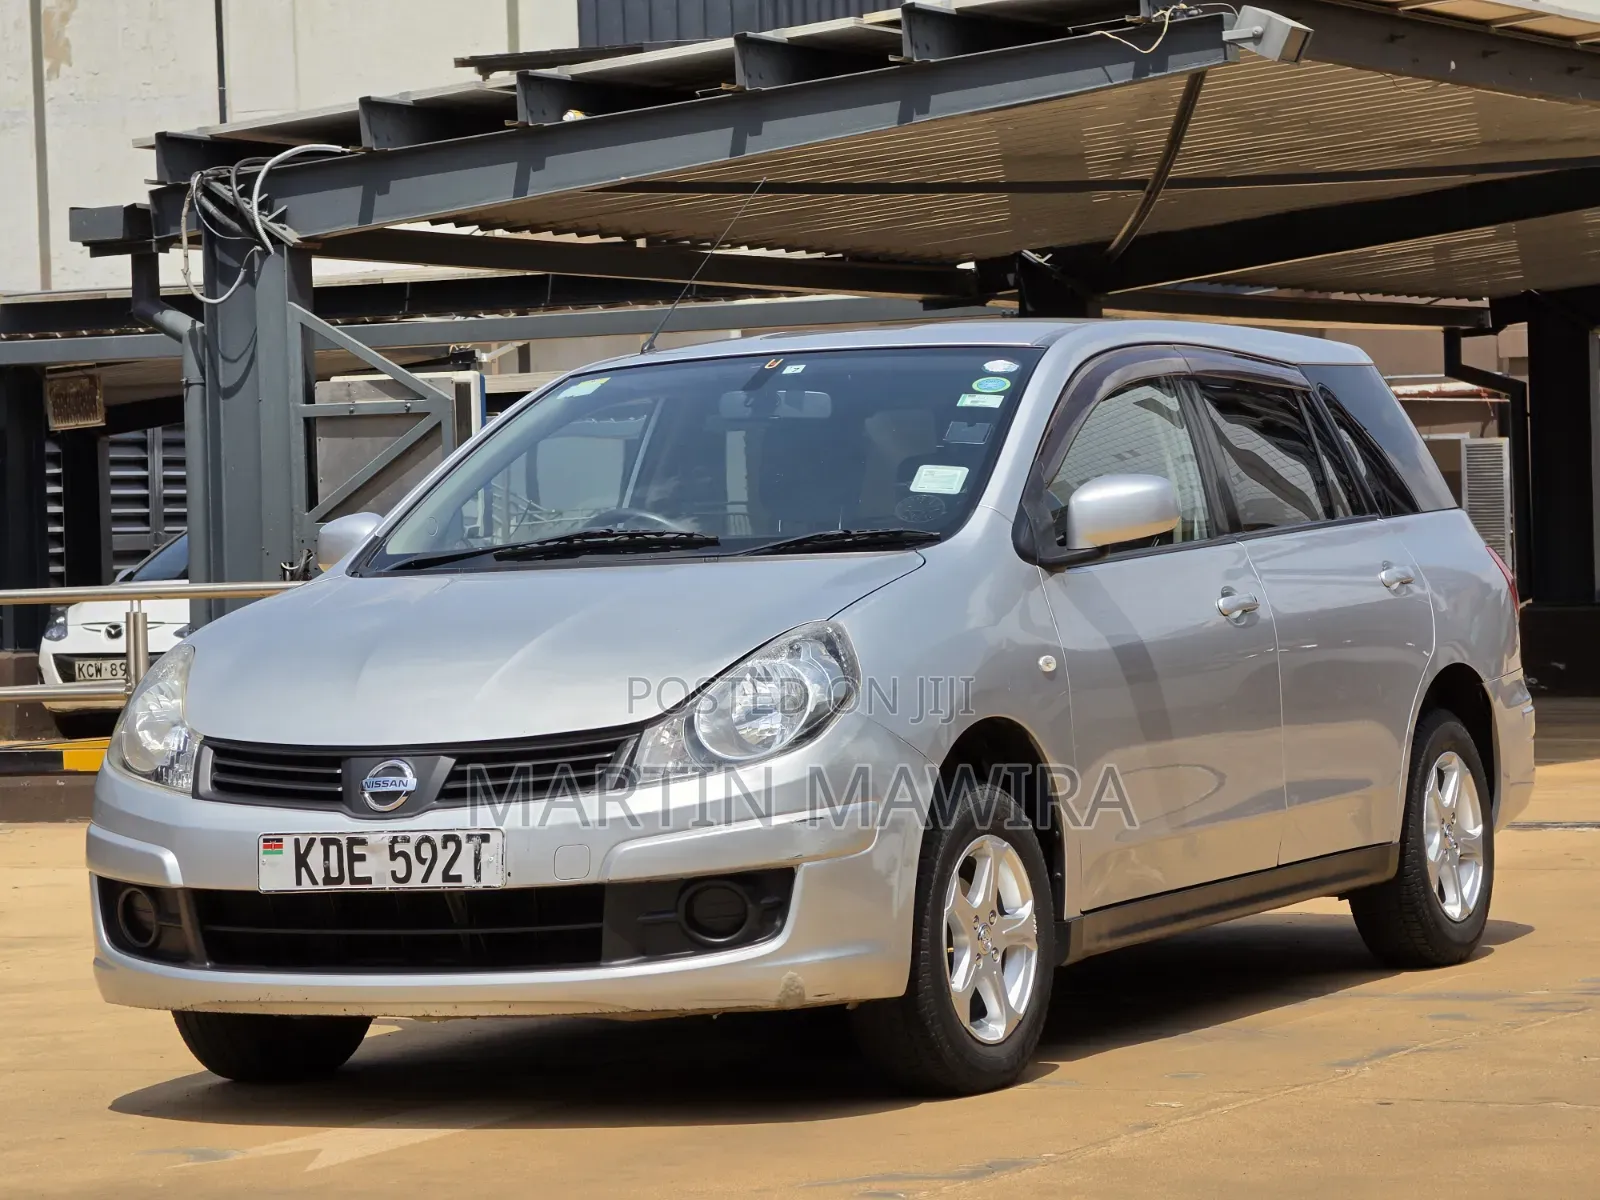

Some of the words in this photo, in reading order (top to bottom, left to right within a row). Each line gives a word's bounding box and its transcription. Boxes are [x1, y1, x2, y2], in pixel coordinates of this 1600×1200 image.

[77, 663, 102, 678] KCW
[364, 779, 409, 790] NISSAN
[294, 836, 373, 886] KDE
[388, 833, 491, 884] 592T
